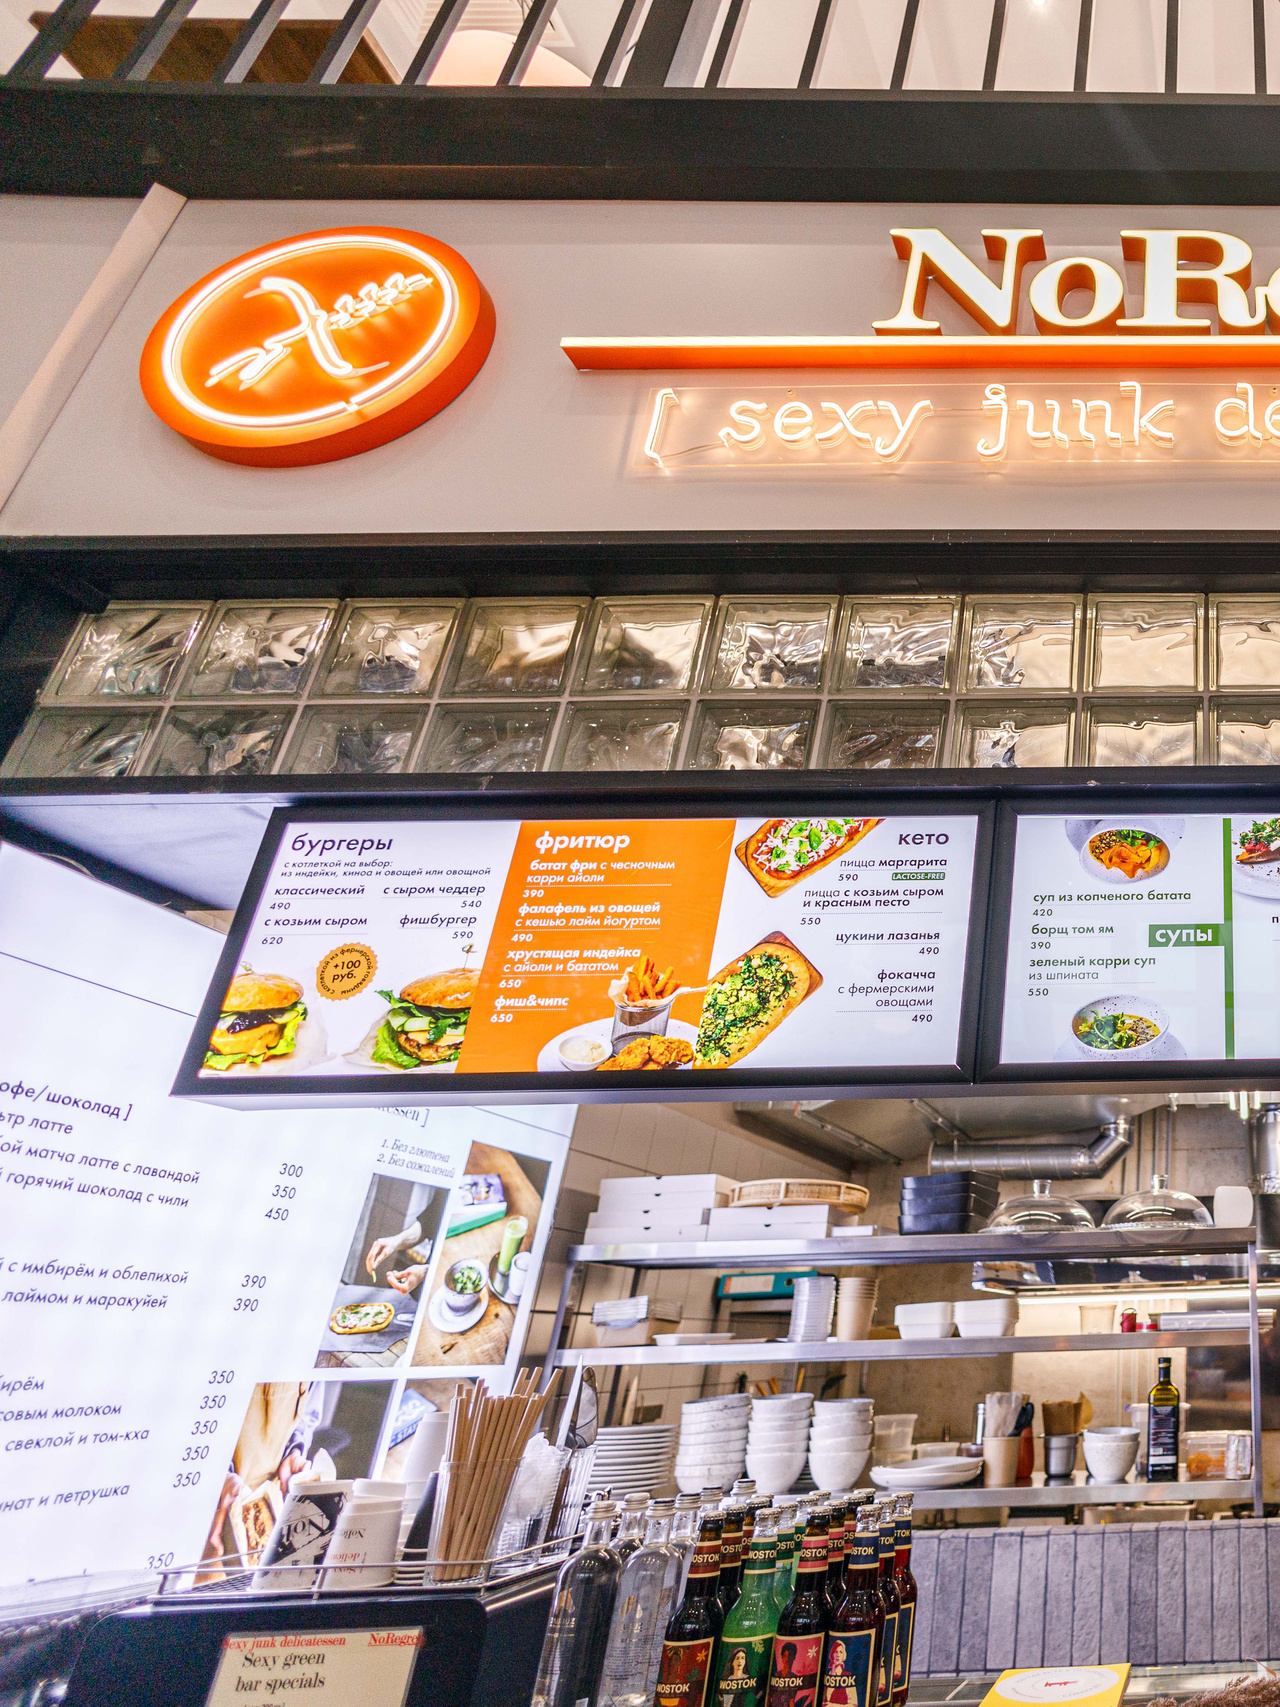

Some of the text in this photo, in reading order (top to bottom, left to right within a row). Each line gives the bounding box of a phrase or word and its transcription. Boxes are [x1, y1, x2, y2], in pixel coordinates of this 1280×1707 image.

[721, 396, 935, 456] sexy
[977, 381, 1174, 458] junk
[291, 833, 393, 856] бургеры
[535, 831, 630, 854] фритюр
[898, 833, 949, 846] кето
[291, 859, 341, 868] котлеткой
[358, 859, 393, 869] выбор:
[530, 859, 567, 870] батат
[571, 860, 597, 872] фри
[611, 860, 675, 870] чесночным
[840, 858, 947, 868] пицца маргарита
[526, 871, 605, 885] карри айоли
[838, 873, 858, 882] 590
[892, 872, 944, 880] LACTOSE-FREE
[274, 885, 365, 896] классический
[393, 886, 435, 897] сыром
[439, 885, 485, 897] чеддер
[522, 889, 544, 897] 390
[804, 889, 840, 898] пицца
[854, 888, 899, 896] козьим
[903, 888, 944, 898] сыром
[1033, 894, 1055, 904] суп
[1076, 892, 1144, 903] копченого
[1147, 889, 1191, 900] батата
[270, 902, 291, 910] 490
[461, 900, 482, 908] 540
[518, 902, 660, 915] фалафель из овощей
[1032, 908, 1053, 916] 420
[274, 917, 321, 926] козьим
[325, 917, 367, 928] сыром
[400, 914, 477, 929] фишбургер
[800, 917, 821, 925] 550
[452, 931, 473, 939] 590
[1031, 924, 1114, 935] борщ том ям
[261, 937, 283, 945] 620
[511, 933, 533, 942] 490
[836, 932, 940, 943] цукини лазанья
[1155, 928, 1212, 947] супы
[919, 947, 939, 955] 490
[1031, 941, 1051, 949] 390
[506, 947, 641, 959] хрустящая индейка
[334, 960, 361, 969] +100
[1029, 956, 1156, 969] зеленый карри суп
[332, 969, 356, 983] руб.
[878, 969, 936, 982] фокачча
[1028, 970, 1098, 980] из шпината
[499, 979, 521, 987] 650
[1028, 988, 1049, 996] 550
[494, 995, 568, 1009] фиш&чипс
[876, 998, 932, 1008] овощами
[491, 1014, 512, 1022] 650
[912, 1014, 932, 1022] 490
[28, 1118, 73, 1134] латте
[391, 1139, 408, 1153] Без
[409, 1147, 451, 1162] глютена
[25, 1147, 200, 1184] матча латте с лавандой
[279, 1163, 303, 1178] 300
[388, 1153, 405, 1167] Без
[406, 1161, 455, 1178] сожалений
[6, 1172, 189, 1208] горячий шоколад с чили
[272, 1184, 296, 1199] 350
[264, 1208, 289, 1221] 450
[8, 1259, 189, 1284] с имбирём и облепихой
[241, 1275, 266, 1289] 390
[2, 1288, 168, 1311] лаймом и маракуйей
[233, 1299, 259, 1312] 390
[208, 1370, 234, 1384] 350
[200, 1395, 226, 1409] 350
[51, 1405, 122, 1418] молоком
[191, 1420, 218, 1435] 350
[5, 1429, 149, 1451] свеклой и том-кха
[182, 1446, 209, 1461] 350
[173, 1471, 200, 1488] 350
[38, 1485, 130, 1507] и петрушка
[249, 1635, 276, 1651] junk
[280, 1635, 346, 1648] delicatessen
[242, 1652, 325, 1671] Sexy green
[236, 1672, 325, 1695] bar specials
